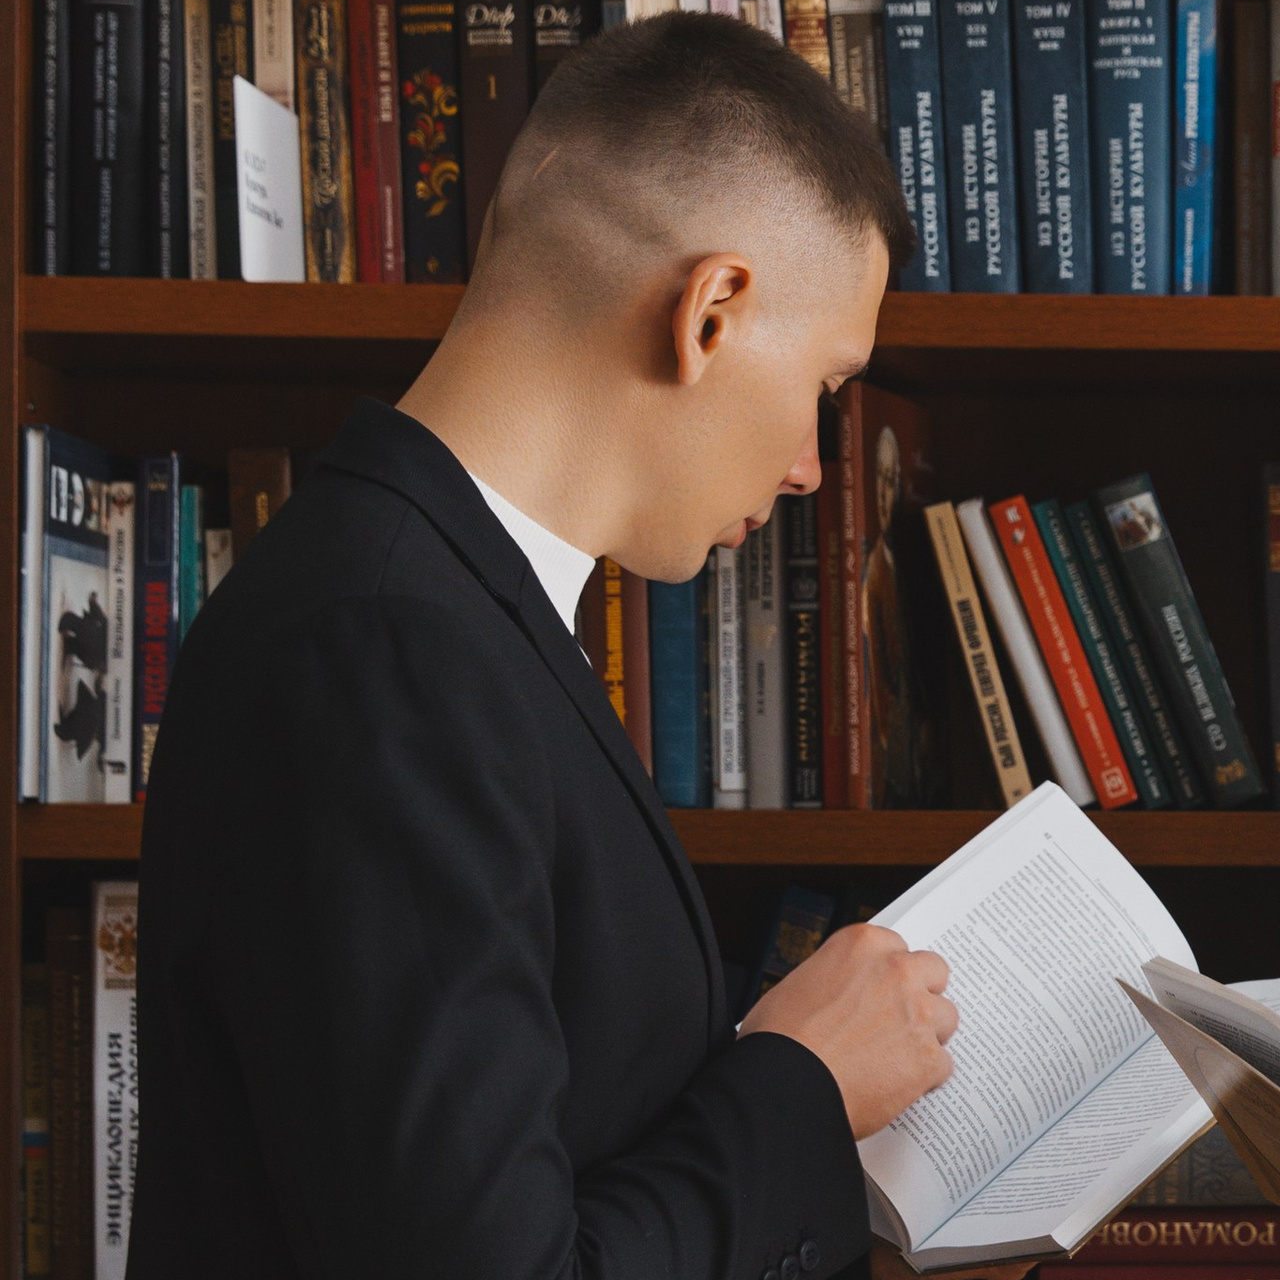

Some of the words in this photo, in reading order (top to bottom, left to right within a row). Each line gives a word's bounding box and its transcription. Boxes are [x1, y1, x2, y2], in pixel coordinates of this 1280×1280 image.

[886, 2, 914, 18] ТОМ
[915, 0, 932, 17] III
[955, 1, 984, 17] ТОМ
[1025, 5, 1053, 20] ТОМ
[1055, 1, 1072, 19] IV
[1099, 16, 1141, 30] КНИГА
[899, 125, 917, 212] ИСТОРИИ
[915, 90, 937, 187] КУЛЬТУРЫ
[962, 123, 980, 211] ИСТОРИИ
[979, 88, 999, 185] КУЛЬТУРЫ
[1034, 128, 1052, 216] ИСТОРИИ
[1052, 92, 1072, 190] КУЛЬТУРЫ
[1127, 101, 1145, 200] КУЛЬТУРЫ
[1109, 137, 1125, 225] ИСТОРИИ
[920, 192, 941, 278] РУССКОЙ
[965, 216, 981, 243] ИЗ
[983, 190, 1003, 277] РУССКОЙ
[1037, 220, 1053, 248] ИЗ
[1055, 194, 1075, 281] РУССКОЙ
[1110, 230, 1126, 258] ИЗ
[1129, 204, 1147, 291] РУССКОЙ
[845, 580, 858, 652] ЛОМОНОСОВ
[1159, 602, 1195, 664] РОССИЯН
[1182, 662, 1217, 723] ВЕЛИКИХ
[1204, 721, 1228, 753] СТО
[106, 1031, 126, 1247] ЭНЦИКЛОПЕДИЯ
[1098, 1221, 1276, 1248] РОМАНОВЫ
